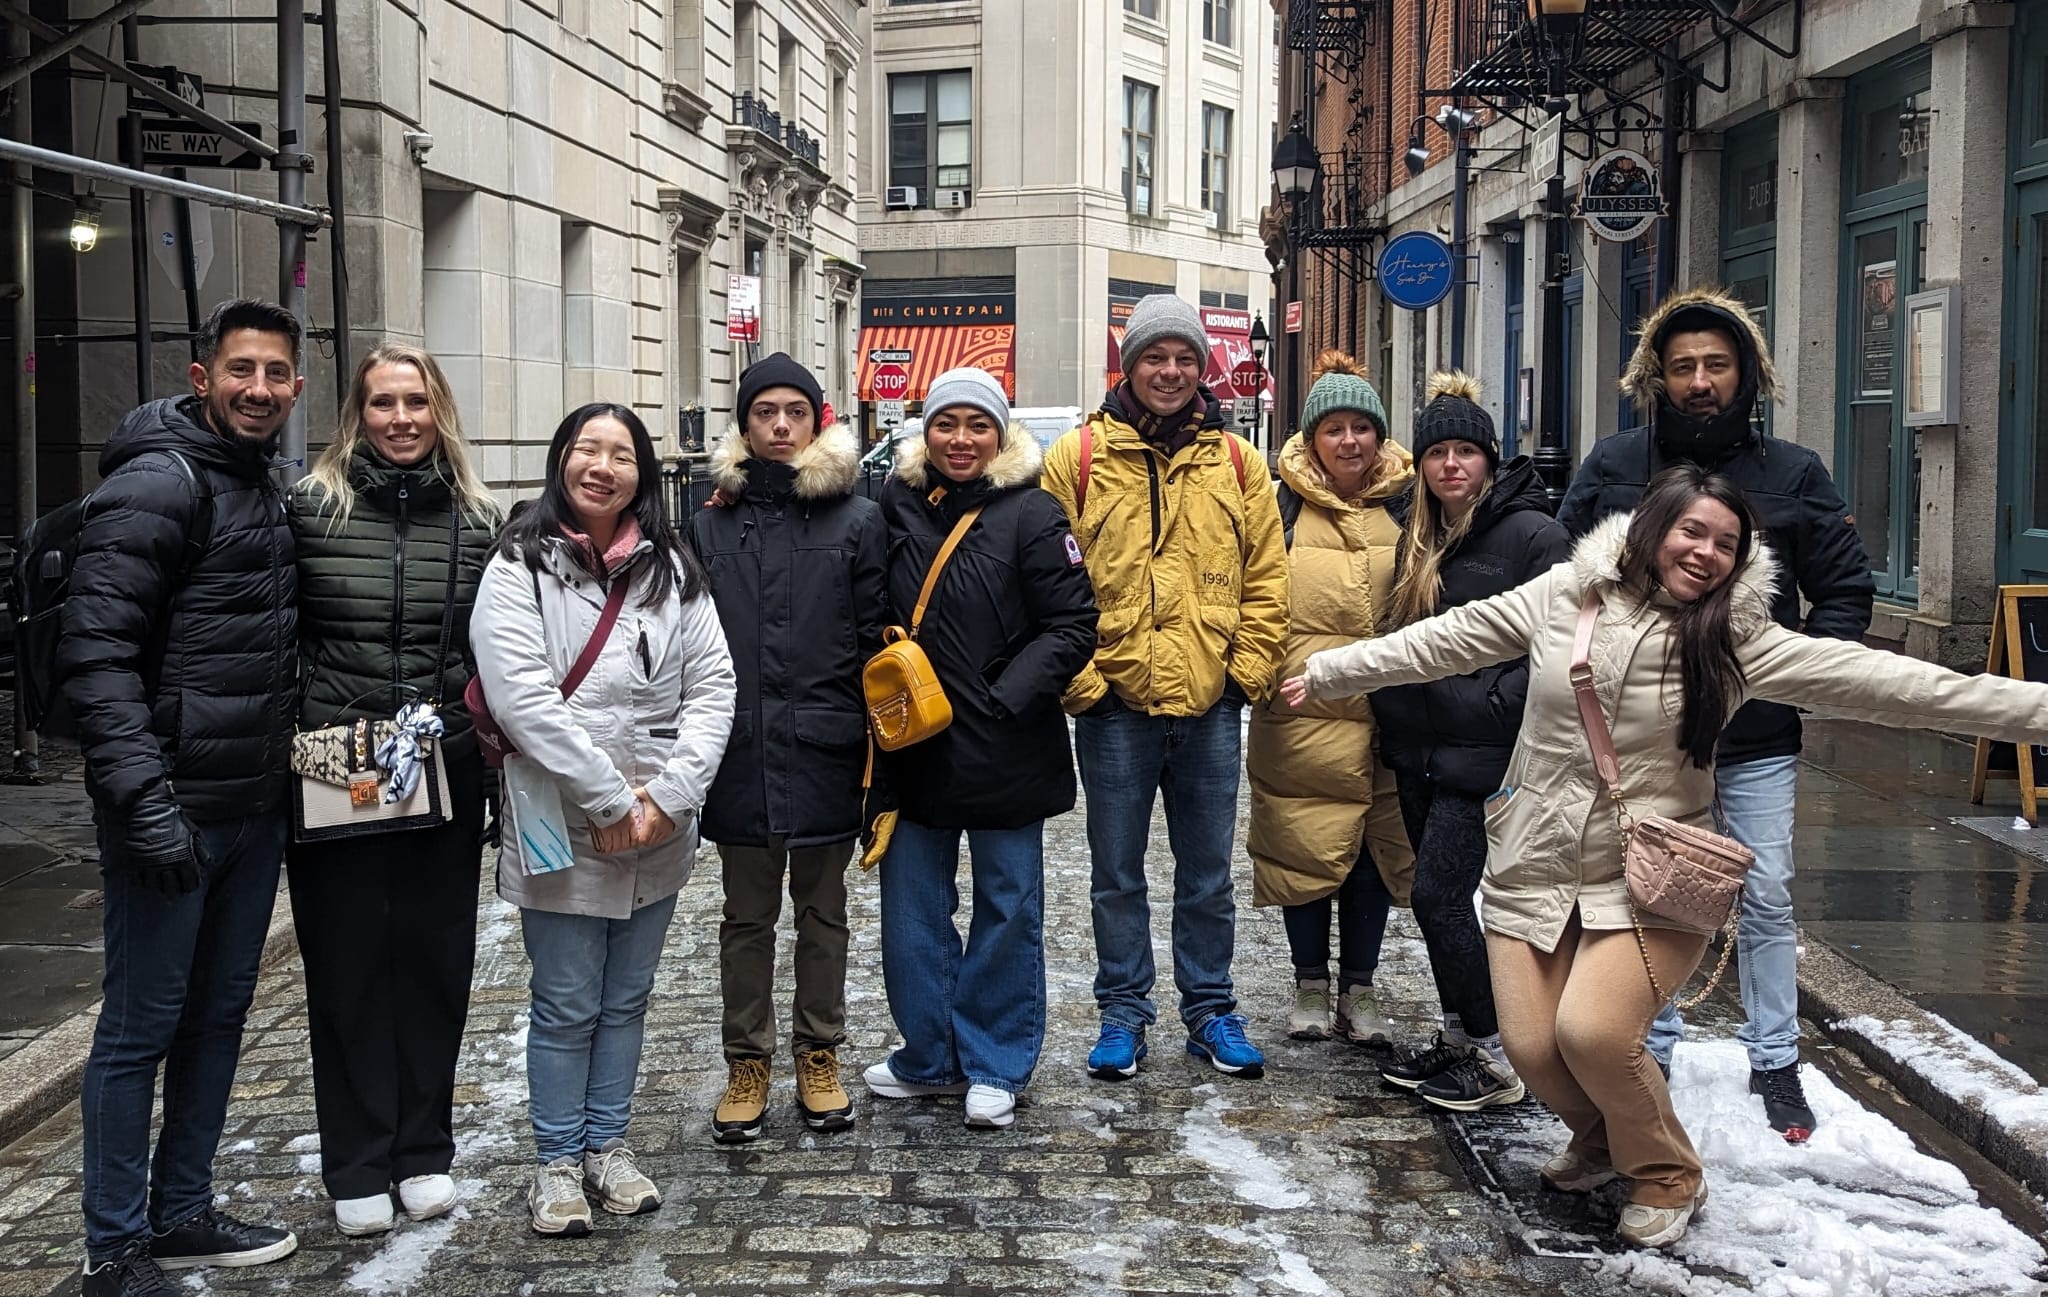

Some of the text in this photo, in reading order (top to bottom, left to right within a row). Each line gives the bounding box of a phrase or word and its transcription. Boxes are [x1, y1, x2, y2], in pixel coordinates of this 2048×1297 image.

[143, 134, 222, 153] NE WAY
[1749, 181, 1771, 209] PUB
[873, 305, 1003, 317] WITH CHUTZPAH
[1206, 313, 1249, 329] RISTORANTE
[963, 328, 1010, 348] LEO'S
[875, 375, 906, 389] STOP
[1233, 371, 1266, 386] STOP
[1202, 572, 1230, 587] 1990
